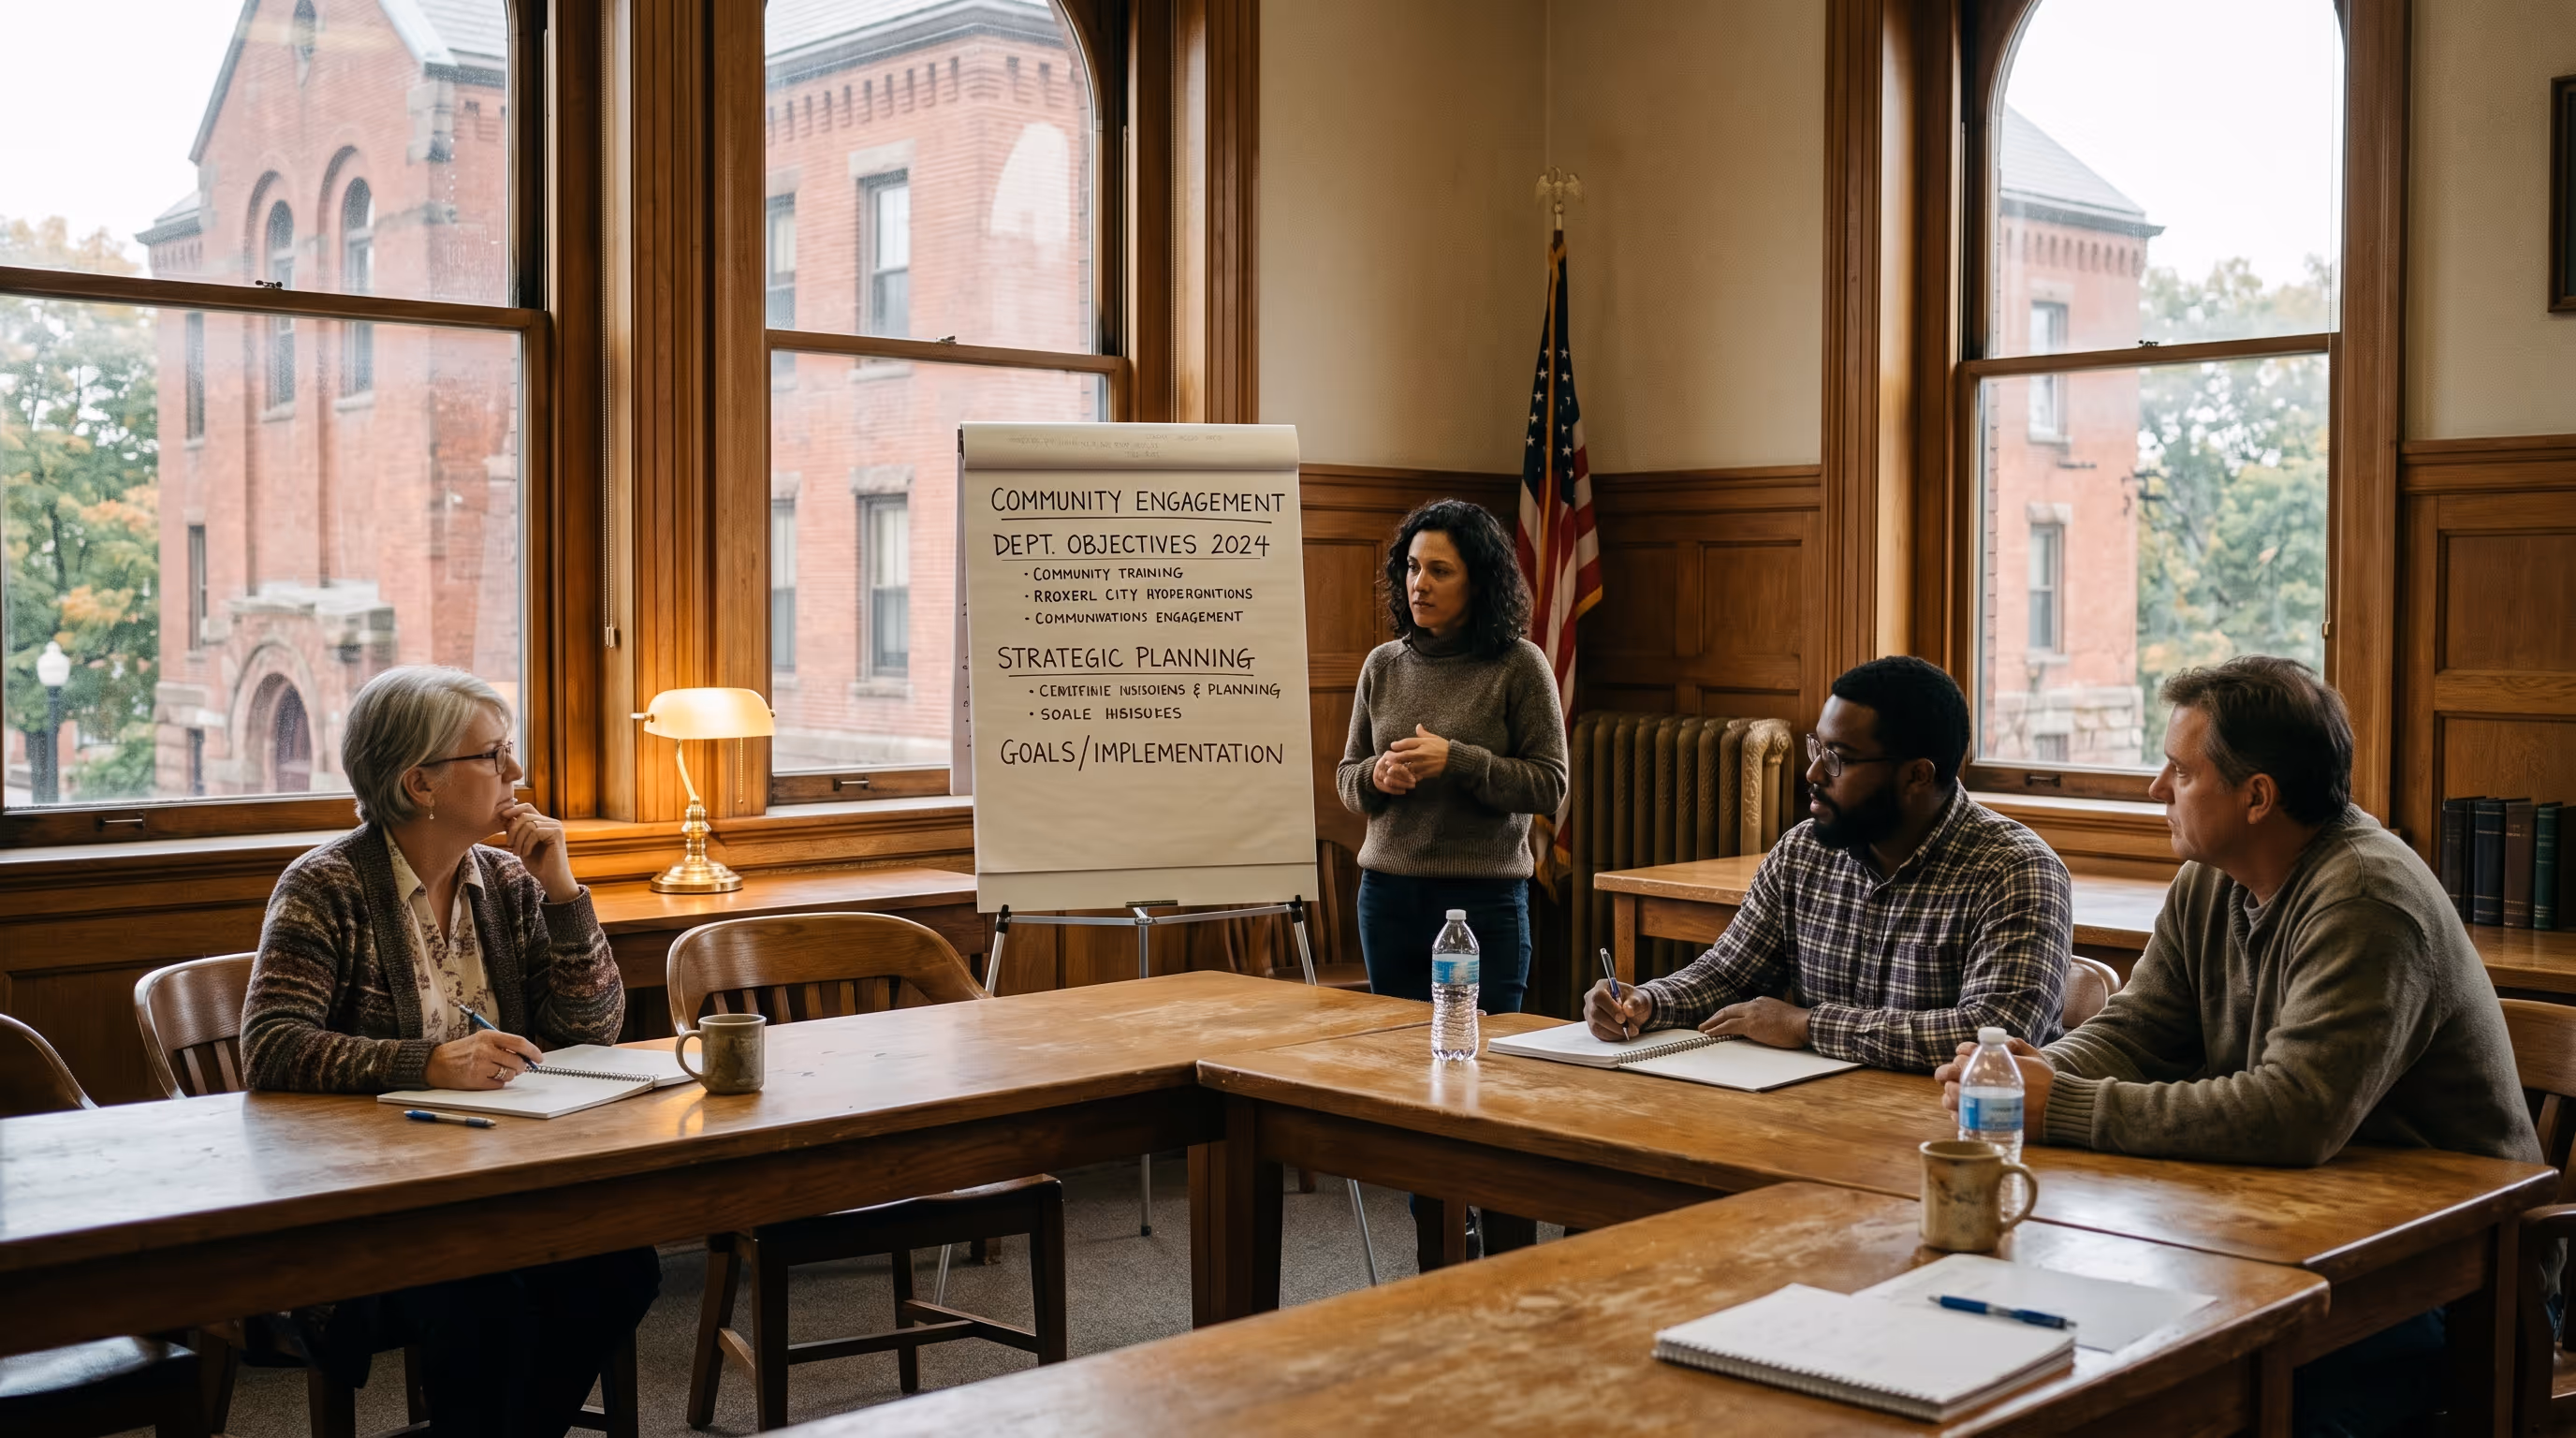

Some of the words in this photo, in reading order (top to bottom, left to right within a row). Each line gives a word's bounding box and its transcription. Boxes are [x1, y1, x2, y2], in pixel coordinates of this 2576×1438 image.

[991, 487, 1122, 514] COMMUNITY
[1136, 491, 1286, 513] ENGAGEMENT
[993, 534, 1055, 556] DEPT.
[1067, 534, 1197, 555] OBJECTIVES
[1210, 534, 1270, 557] 2024
[1033, 566, 1110, 581] COMMUNITY
[1118, 566, 1184, 580] TRAINING
[1105, 588, 1138, 602] CITY
[1156, 610, 1244, 624] ENGAGEMENT
[998, 646, 1124, 669] STRATEGIC
[1135, 646, 1256, 670] PLANNING
[1193, 682, 1201, 699] &
[1208, 682, 1281, 699] PLANNING
[1040, 708, 1091, 721] SOALE
[1000, 734, 1283, 771] GOALS/IMPLEMENTATION
